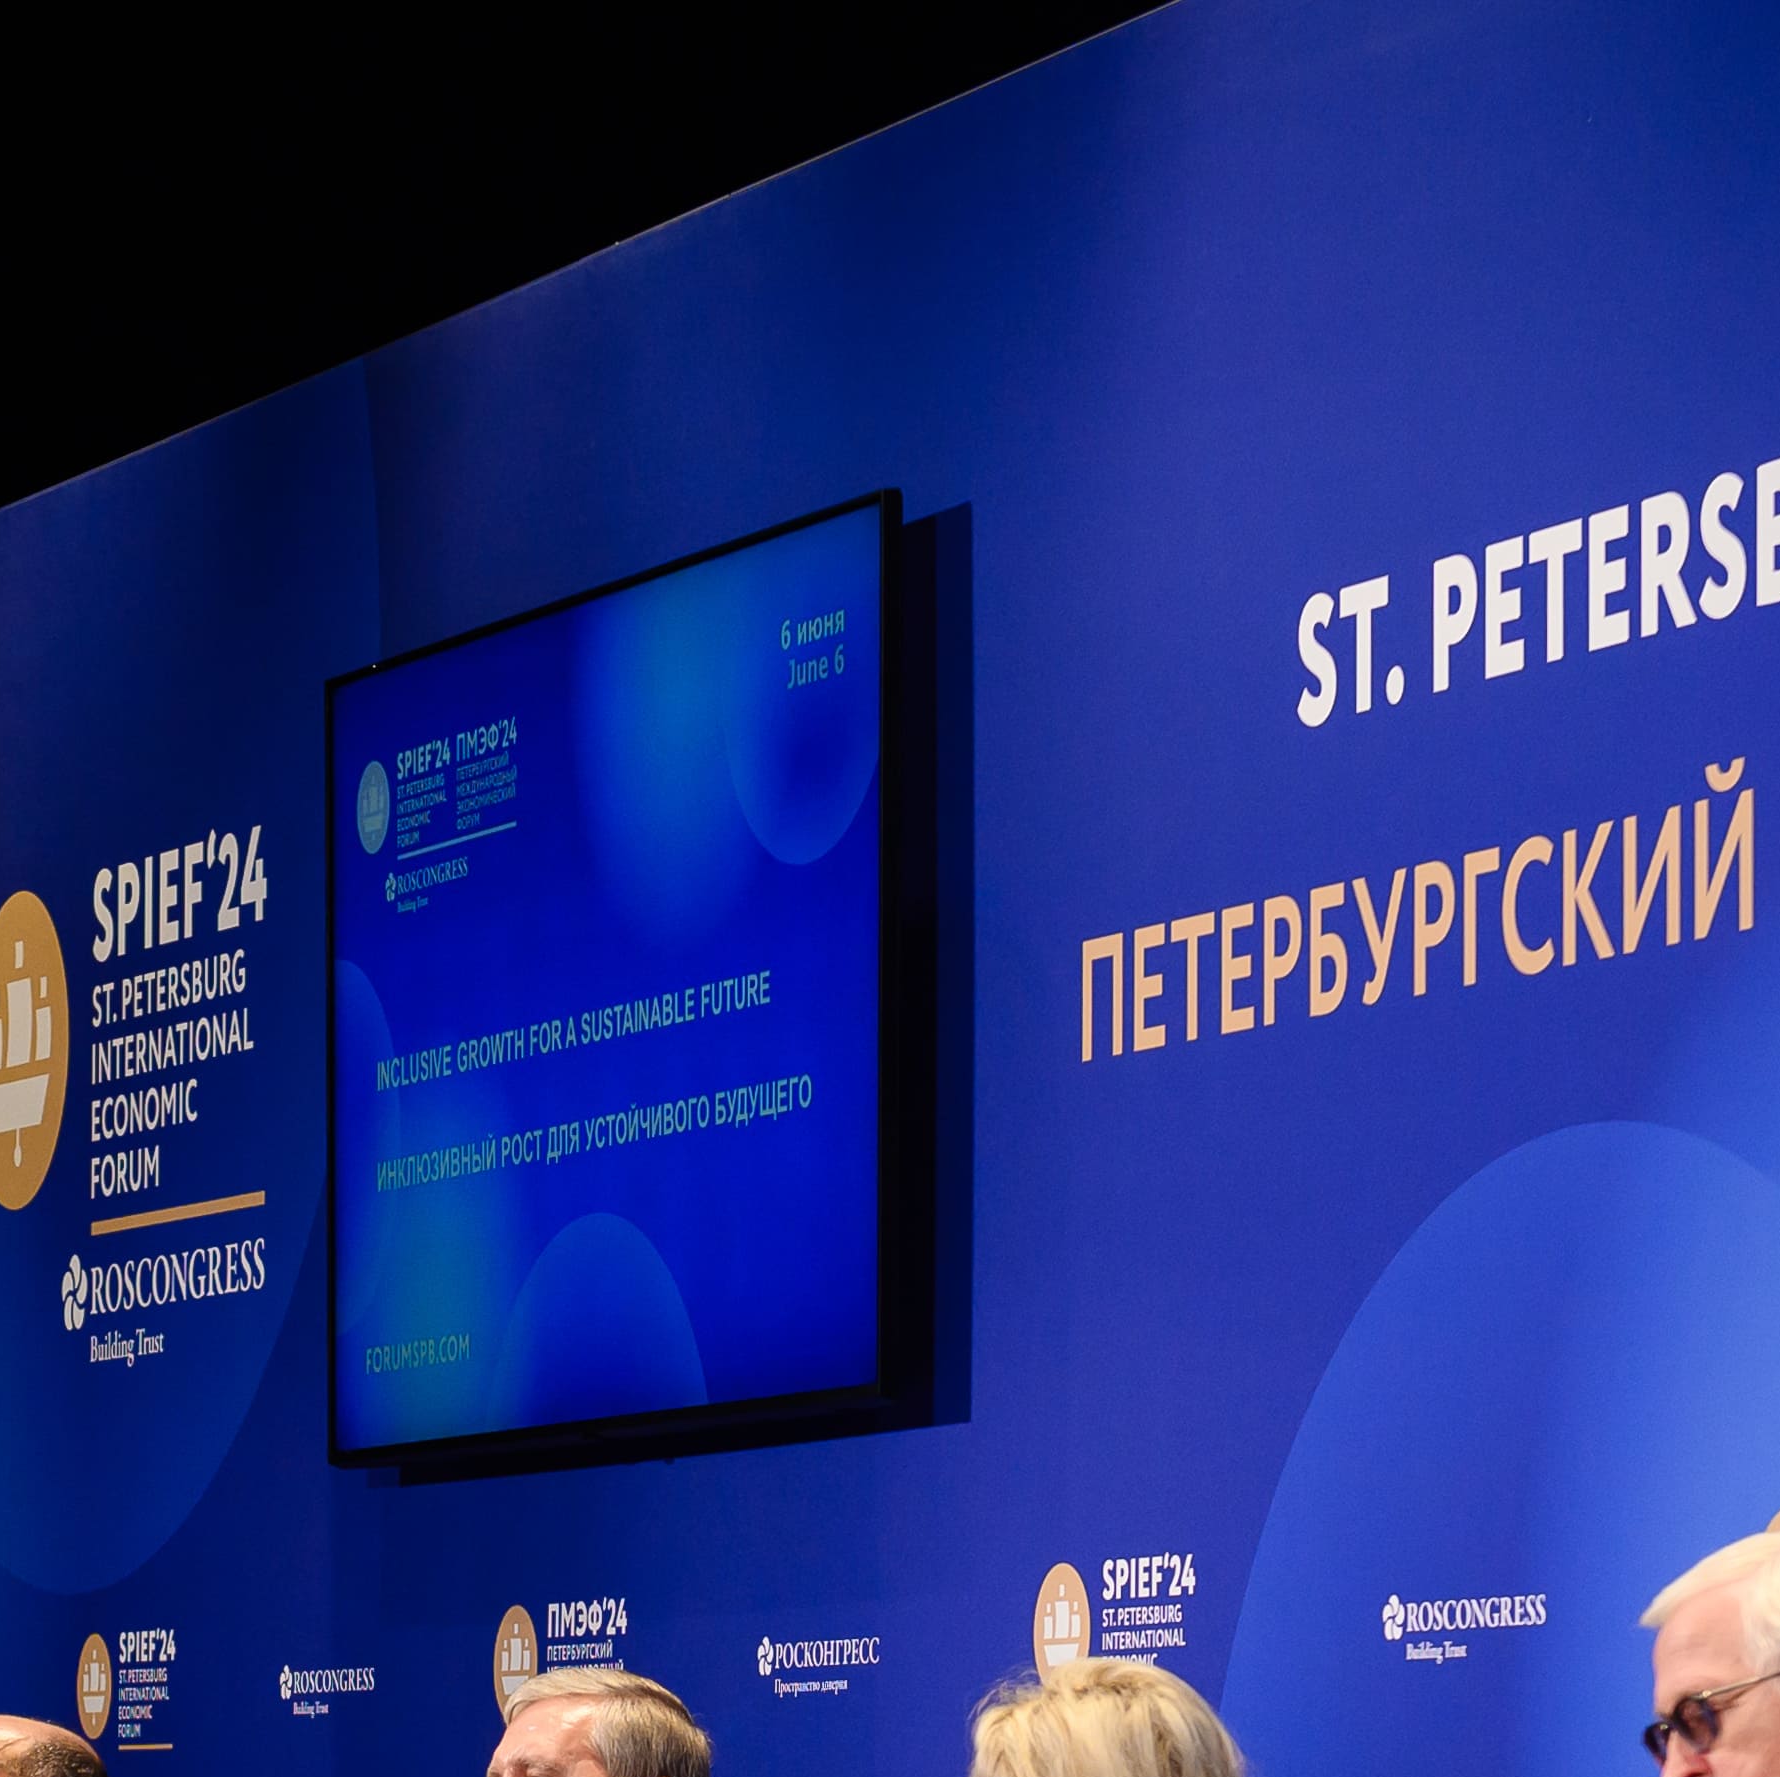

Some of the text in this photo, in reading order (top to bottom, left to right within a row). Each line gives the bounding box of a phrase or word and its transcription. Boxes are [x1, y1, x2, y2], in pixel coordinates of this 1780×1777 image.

[780, 609, 846, 651] 6 июня
[787, 643, 845, 689] June 6
[1297, 575, 1405, 727] ST.
[92, 825, 267, 962] SPIEF'24
[397, 856, 468, 896] ROSCONGRESS
[1082, 757, 1753, 1063] ПЕТЕРБУРГСКИЙ
[91, 949, 246, 1028] ST. PETERSBURG
[91, 1008, 255, 1085] INTERNATIONAL
[377, 970, 771, 1091] INCLUSIVE GROWTH FOR A SUSTAINABLE FUTURE
[91, 1079, 198, 1143] ECONOMIC
[377, 1074, 812, 1191] ИНКЛЮЗИВНЫЙ РОСТ ДЛЯ УСТОЙЧИВОГО БУДУЩЕГО
[91, 1145, 160, 1199] FORUM
[90, 1238, 266, 1317] ROSCONGRESS
[90, 1328, 164, 1368] Building Trust
[366, 1333, 470, 1374] FORUMSPB.COM
[1102, 1551, 1196, 1600] SPIEF'24
[547, 1596, 627, 1638] ПМЭФ'24
[1102, 1604, 1182, 1627] ST. PETERSBURG
[1406, 1594, 1546, 1633] ROSCONGRESS
[119, 1627, 176, 1664] SPIEF'24
[547, 1639, 613, 1662] ПЕТЕРБУРГСКИЙ
[775, 1637, 880, 1669] РОСКОНГРЕСС
[1102, 1628, 1186, 1651] INTERNATIONAL
[1406, 1641, 1467, 1664] Building Trust
[119, 1686, 169, 1701] INTERNATIONAL
[127, 1667, 168, 1683] PETERSBURG
[293, 1666, 375, 1696] ROSCONGRESS
[118, 1704, 153, 1720] ECONOMIC
